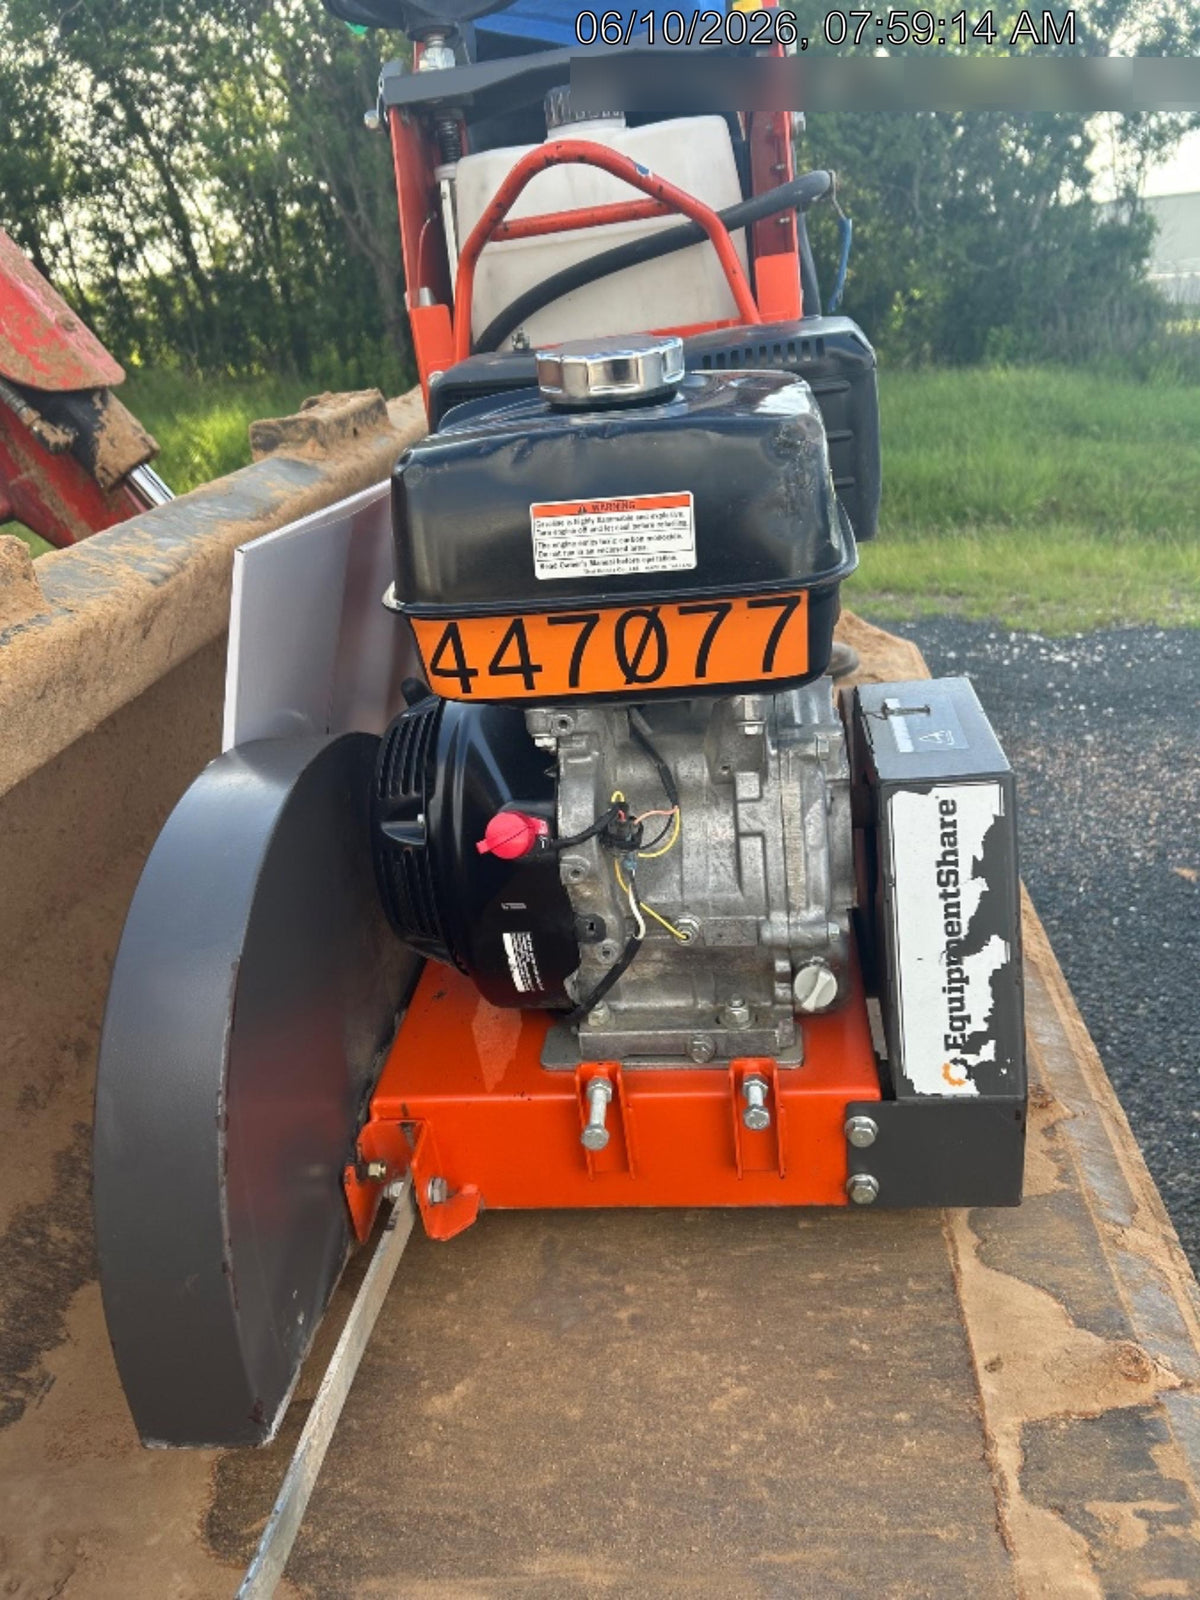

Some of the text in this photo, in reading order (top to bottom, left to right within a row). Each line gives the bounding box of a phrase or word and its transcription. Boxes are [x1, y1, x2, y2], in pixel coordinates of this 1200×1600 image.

[592, 501, 636, 512] WARNING
[429, 595, 803, 694] 447077
[936, 799, 971, 1051] EquipmentShare
